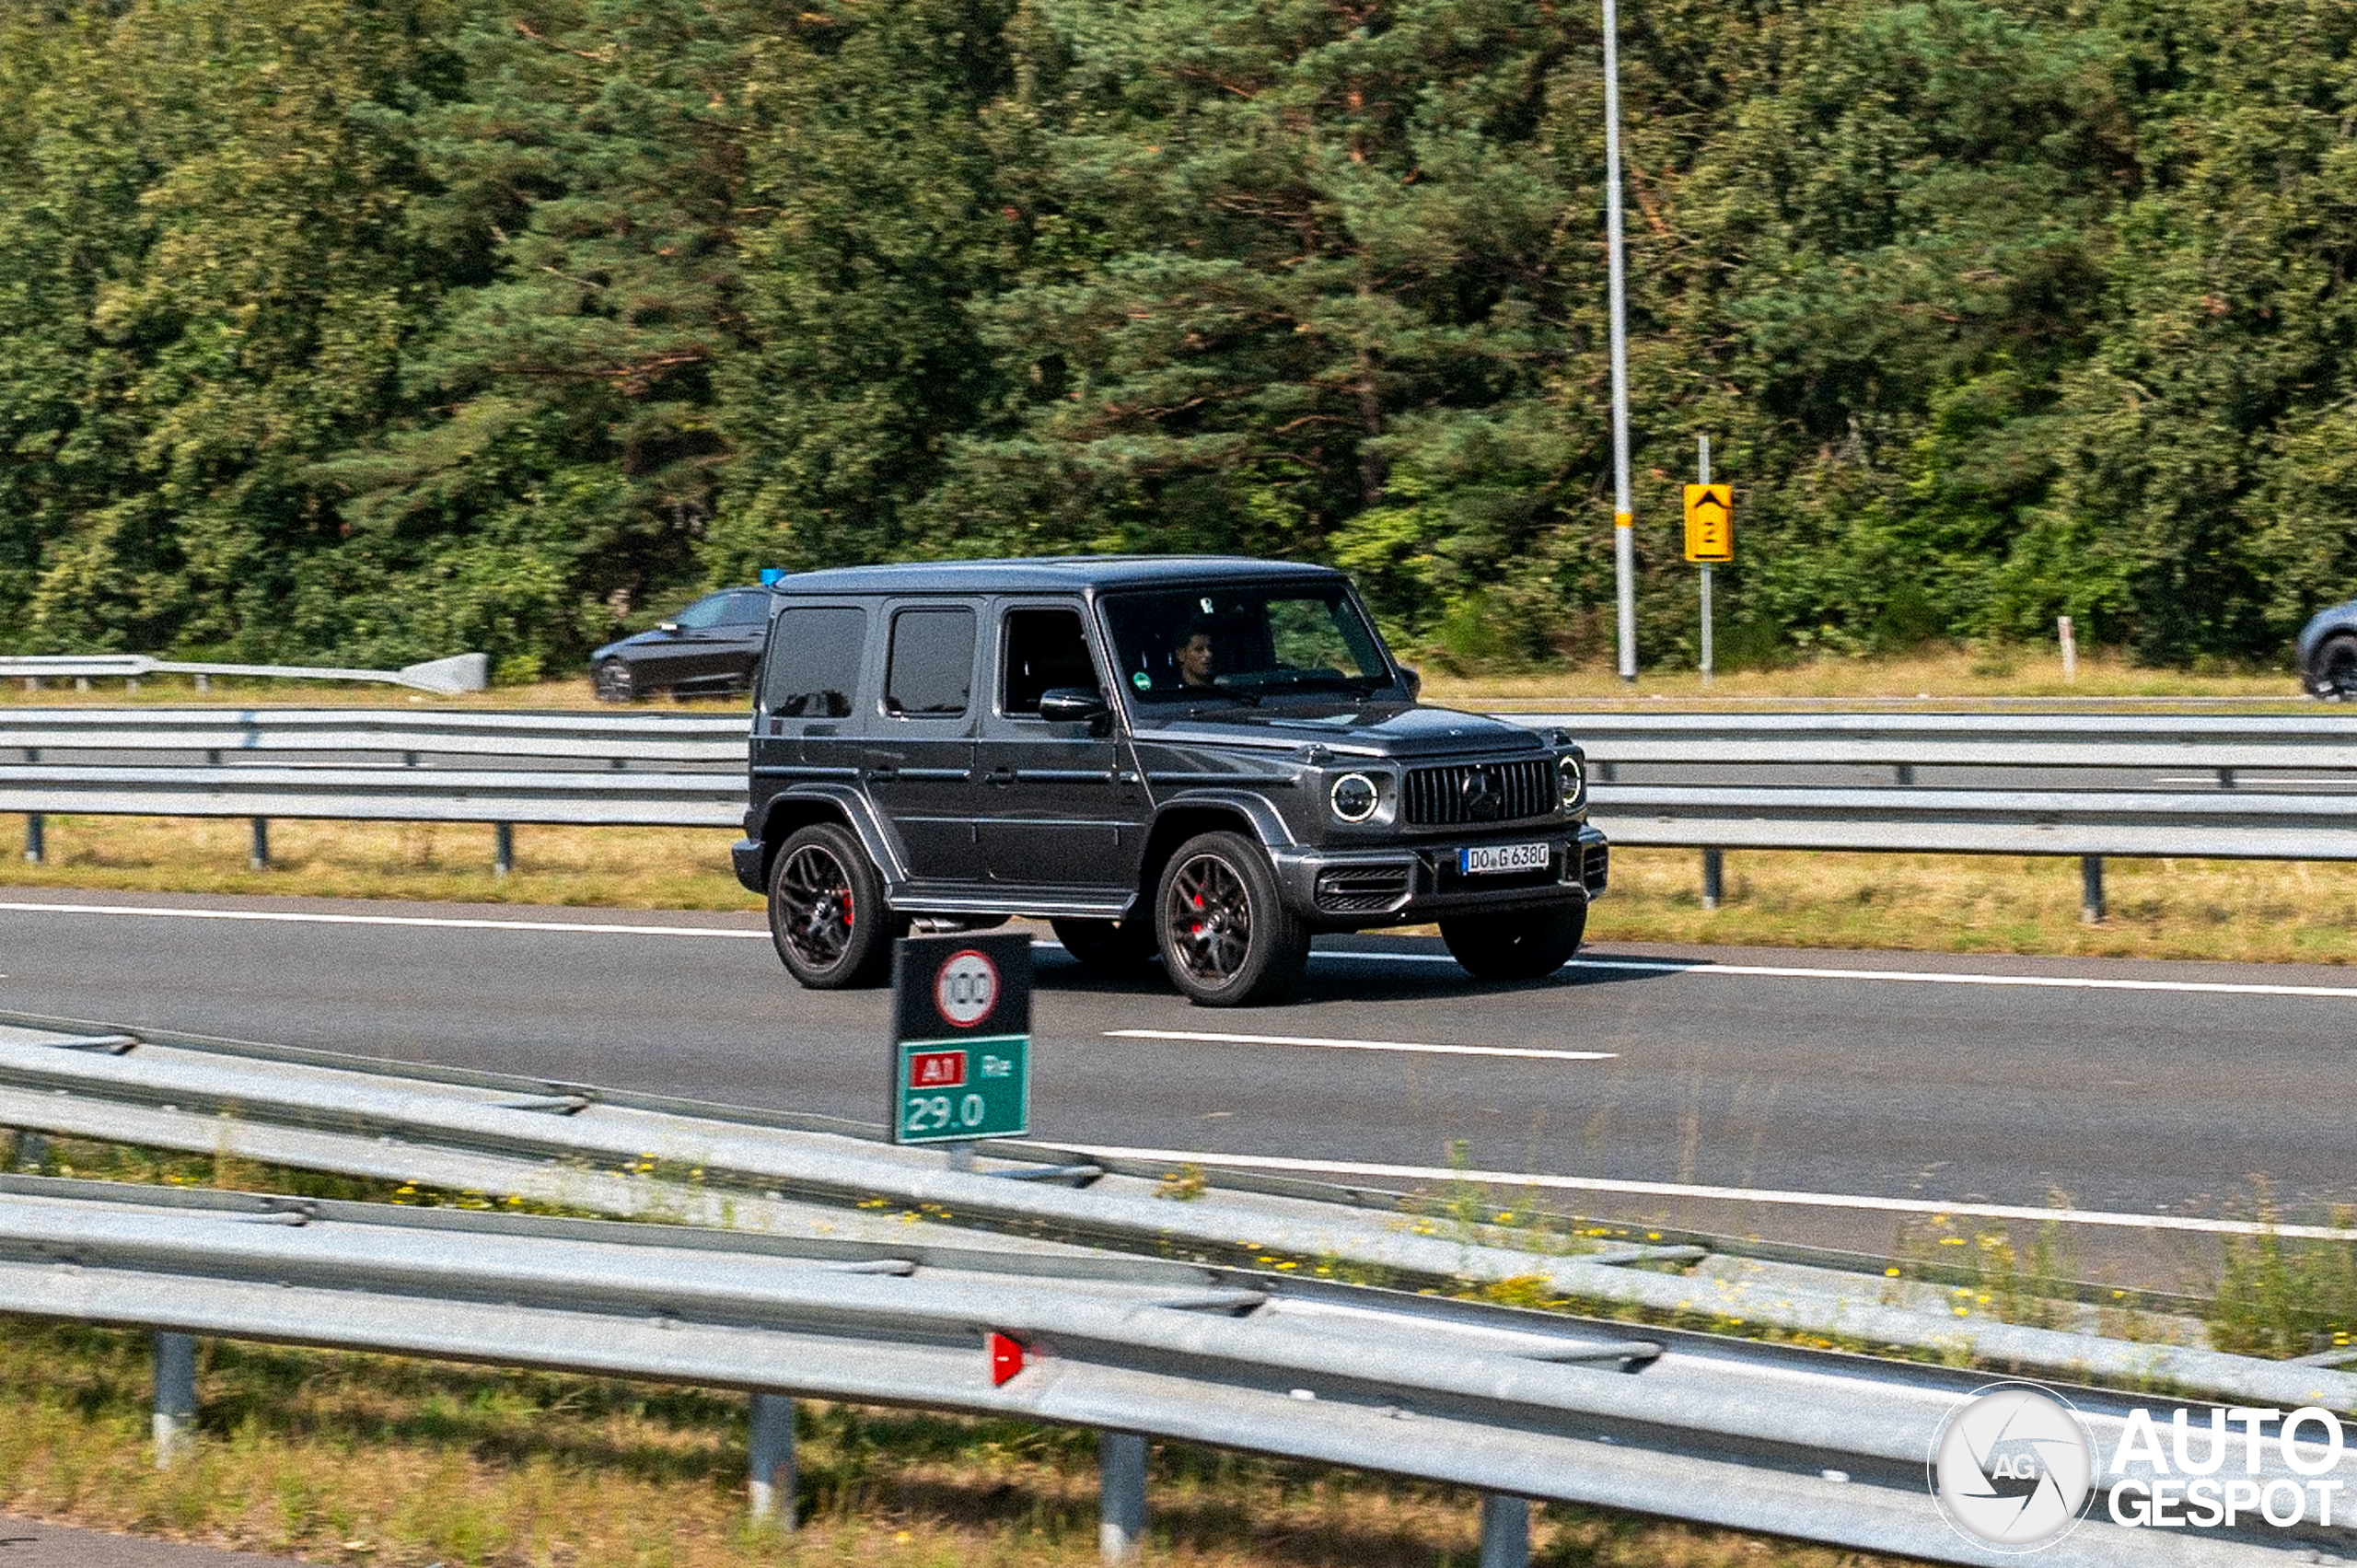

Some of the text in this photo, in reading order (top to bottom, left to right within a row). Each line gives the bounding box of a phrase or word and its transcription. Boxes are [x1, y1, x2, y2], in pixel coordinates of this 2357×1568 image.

[1470, 845, 1547, 868] DO G 6380
[922, 1054, 1012, 1082] A1 Re
[906, 1093, 986, 1131] 29.0
